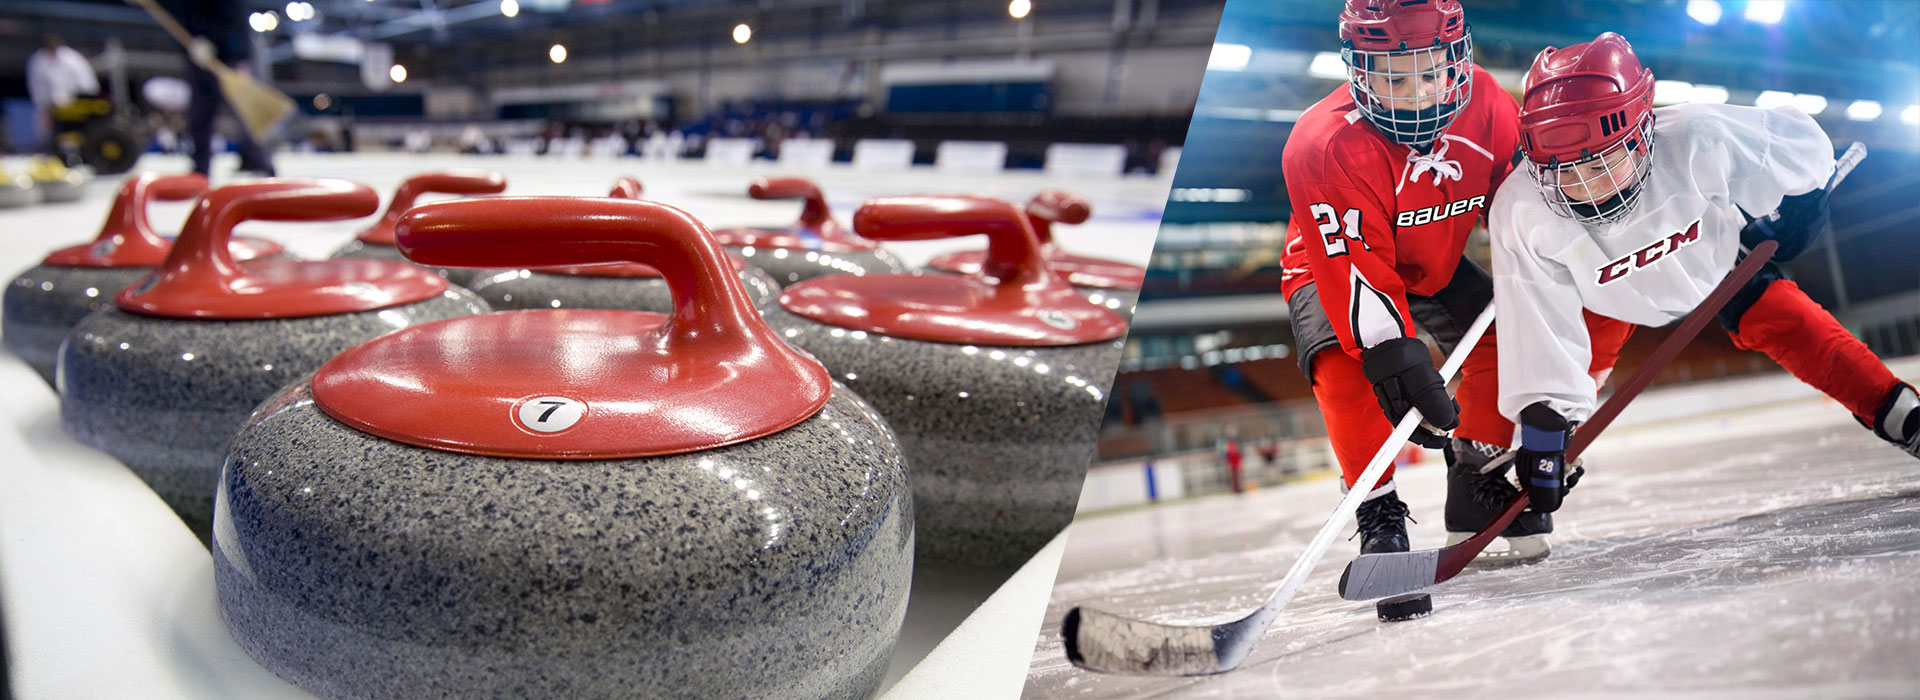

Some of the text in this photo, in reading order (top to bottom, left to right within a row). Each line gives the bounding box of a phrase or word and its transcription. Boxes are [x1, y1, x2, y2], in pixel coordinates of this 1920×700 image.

[1396, 195, 1486, 227] BAUER
[1596, 219, 1701, 285] CCM
[537, 400, 567, 423] 7
[1538, 458, 1554, 473] 28
